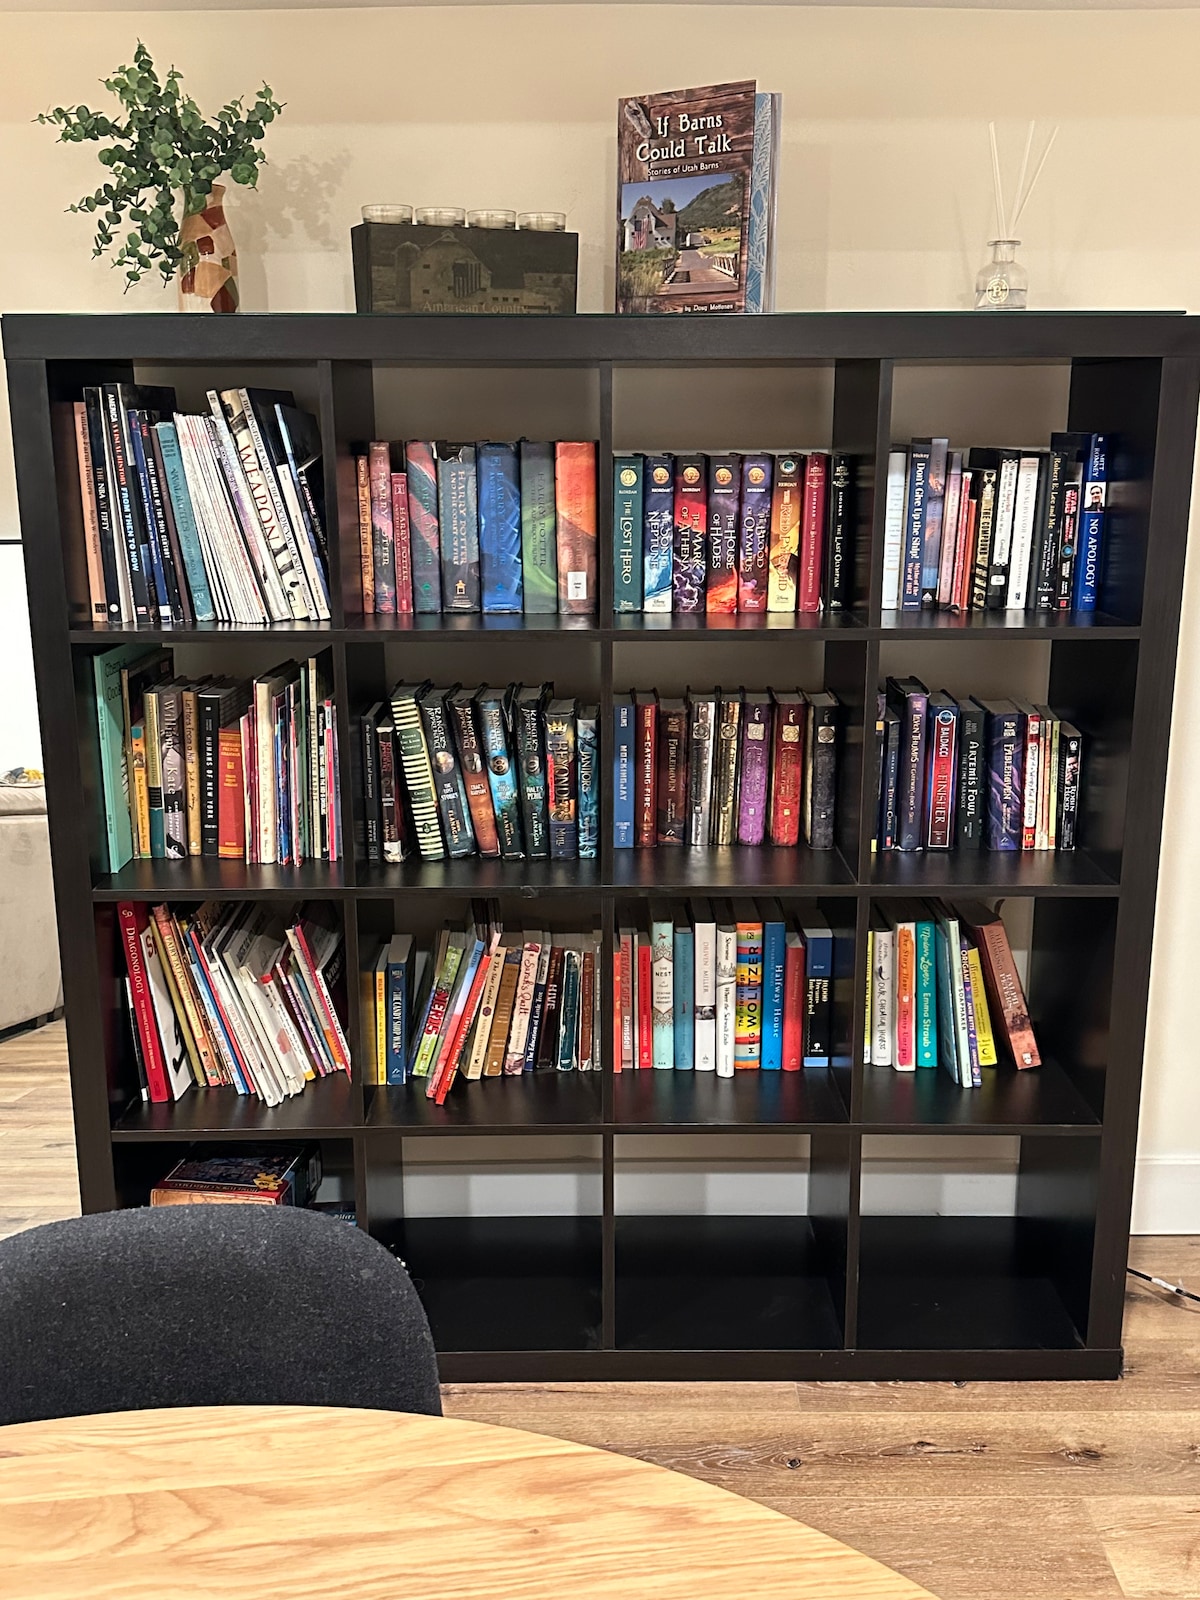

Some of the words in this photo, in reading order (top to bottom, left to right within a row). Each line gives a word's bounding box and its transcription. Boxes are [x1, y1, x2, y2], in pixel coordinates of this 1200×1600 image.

[657, 116, 669, 137] If
[678, 114, 723, 132] Barns
[636, 139, 685, 161] Could
[695, 134, 732, 154] Talk
[648, 168, 676, 176] Stories
[682, 165, 698, 173] Utah
[700, 163, 719, 171] Barns
[107, 394, 118, 422] AMERICA
[79, 411, 89, 440] Vintage
[82, 442, 91, 462] Farm
[1092, 448, 1100, 477] ROMNEY
[117, 455, 126, 486] HISTORY
[915, 462, 925, 486] Don't
[120, 487, 131, 512] FROM
[238, 444, 280, 542] WEAPON
[242, 400, 251, 412] THE
[247, 413, 263, 453] KINGFISHER
[261, 455, 270, 474] ATLAS
[271, 486, 279, 498] THE
[289, 546, 303, 575] WORLD
[379, 471, 388, 517] HARRY
[537, 473, 545, 516] HARRY
[913, 488, 925, 506] Give
[623, 500, 632, 515] THE
[682, 507, 688, 519] OF
[912, 510, 923, 520] Up
[983, 508, 992, 520] THE
[1021, 496, 1030, 533] SURVIVOR
[1064, 491, 1072, 514] WARS
[124, 514, 134, 537] THEN
[620, 517, 633, 546] LOST
[713, 514, 720, 525] OF
[780, 504, 793, 533] RED
[912, 521, 922, 536] the
[1089, 519, 1098, 534] NO
[128, 539, 136, 550] TO
[382, 522, 390, 566] POTTER
[648, 511, 658, 569] NEPTUNE
[660, 527, 668, 557] SON
[678, 521, 690, 572] ATHENA
[692, 529, 703, 568] MARK
[710, 527, 722, 568] HADES
[724, 530, 735, 569] HOUSE
[743, 517, 755, 572] OLYMPUS
[755, 525, 765, 568] BLOOD
[910, 537, 922, 559] Ship!
[979, 521, 991, 555] COMPOUND
[130, 551, 139, 572] NOW
[620, 549, 633, 584] HERO
[1085, 537, 1097, 587] APOLOGY
[164, 700, 176, 750] William
[185, 699, 194, 726] Letters
[913, 714, 922, 733] LEVEN
[185, 727, 194, 745] from
[911, 733, 921, 763] THUMPS
[939, 727, 949, 757] BALDACCI
[206, 770, 213, 778] OF
[580, 750, 591, 793] JANITORS
[619, 745, 627, 801] MOCKINGJAY
[967, 741, 979, 785] ARTEMIS
[1003, 744, 1016, 800] FABLEHAVEN
[166, 767, 178, 795] Kate
[206, 782, 214, 797] NEW
[547, 740, 571, 822] BEYONDERS
[935, 774, 948, 824] FINISHER
[967, 789, 978, 816] FOWL
[448, 810, 459, 844] FLANAGAN
[502, 812, 512, 846] FLANAGAN
[556, 827, 565, 847] MULL
[920, 927, 930, 957] Modern
[995, 934, 1004, 954] HELL
[125, 927, 144, 994] DRAGONOLOGY
[165, 935, 178, 957] FAIRY
[172, 958, 185, 980] TALES
[901, 950, 910, 970] Story
[961, 950, 969, 983] ORIGAMI
[490, 972, 498, 985] Star
[522, 959, 536, 990] Sarah's
[747, 946, 759, 1028] WOLITZER
[773, 965, 782, 1003] Halfway
[1006, 973, 1019, 1005] RALPH
[392, 991, 402, 1001] THE
[485, 986, 495, 1005] Garden
[517, 992, 531, 1015] Quilt
[547, 984, 557, 1010] HIVE
[807, 979, 815, 1015] Interpreted
[821, 979, 829, 1002] 10,000
[999, 973, 1013, 1011] PETERS
[393, 1002, 401, 1020] CANDY
[424, 989, 449, 1036] NERDS
[773, 1009, 781, 1038] House
[958, 988, 966, 1031] SOAPMAKER
[392, 1021, 401, 1036] SHOP
[392, 1036, 401, 1049] WAR
[623, 1015, 631, 1050] Ramsdell
